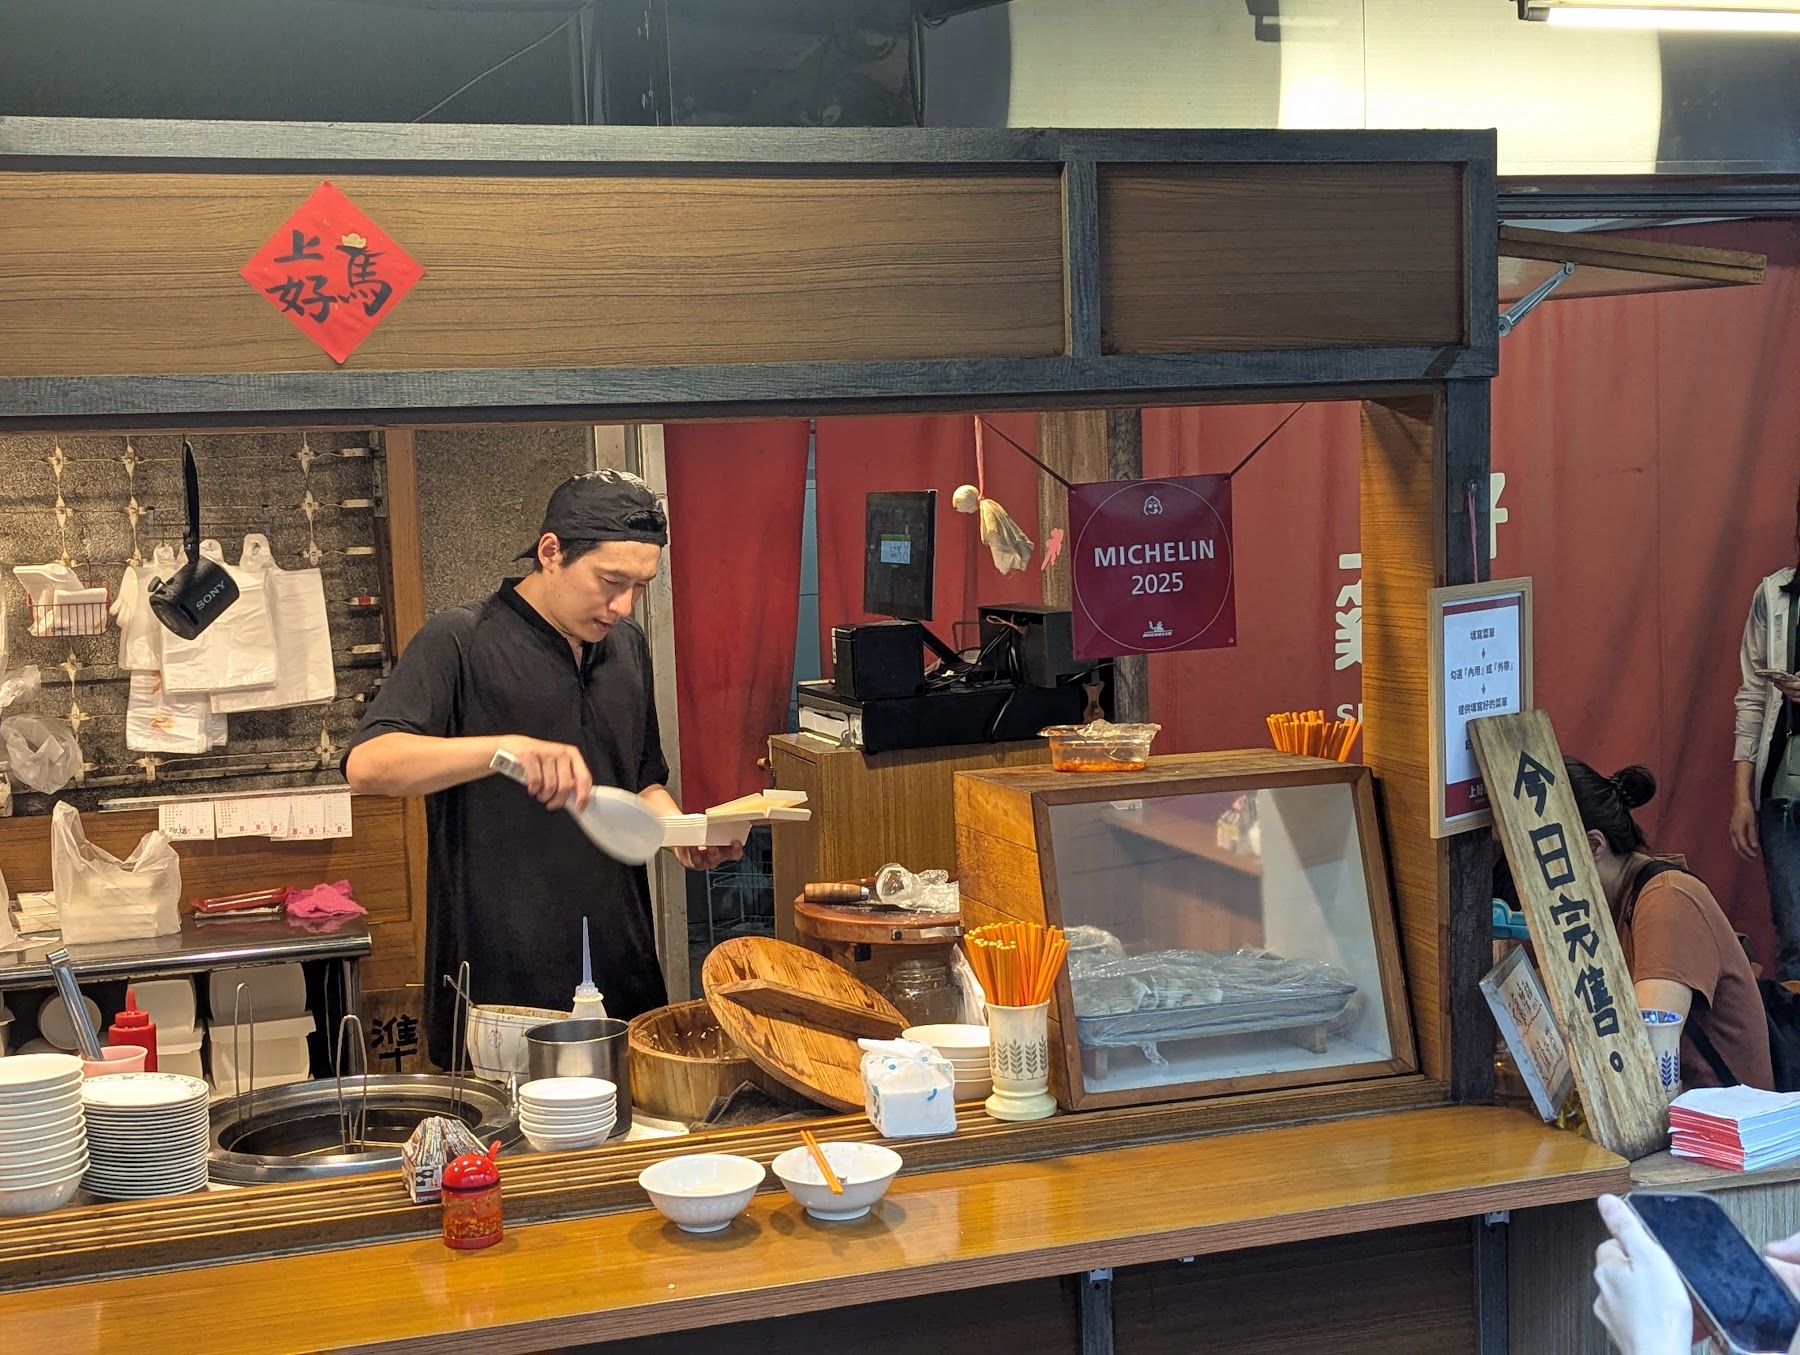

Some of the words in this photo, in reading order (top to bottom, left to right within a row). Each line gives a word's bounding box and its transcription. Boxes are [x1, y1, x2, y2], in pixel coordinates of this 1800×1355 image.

[1094, 539, 1215, 567] MICHELIN
[195, 579, 226, 611] SONY
[1131, 572, 1184, 595] 2025
[1469, 783, 1488, 799] 上好
